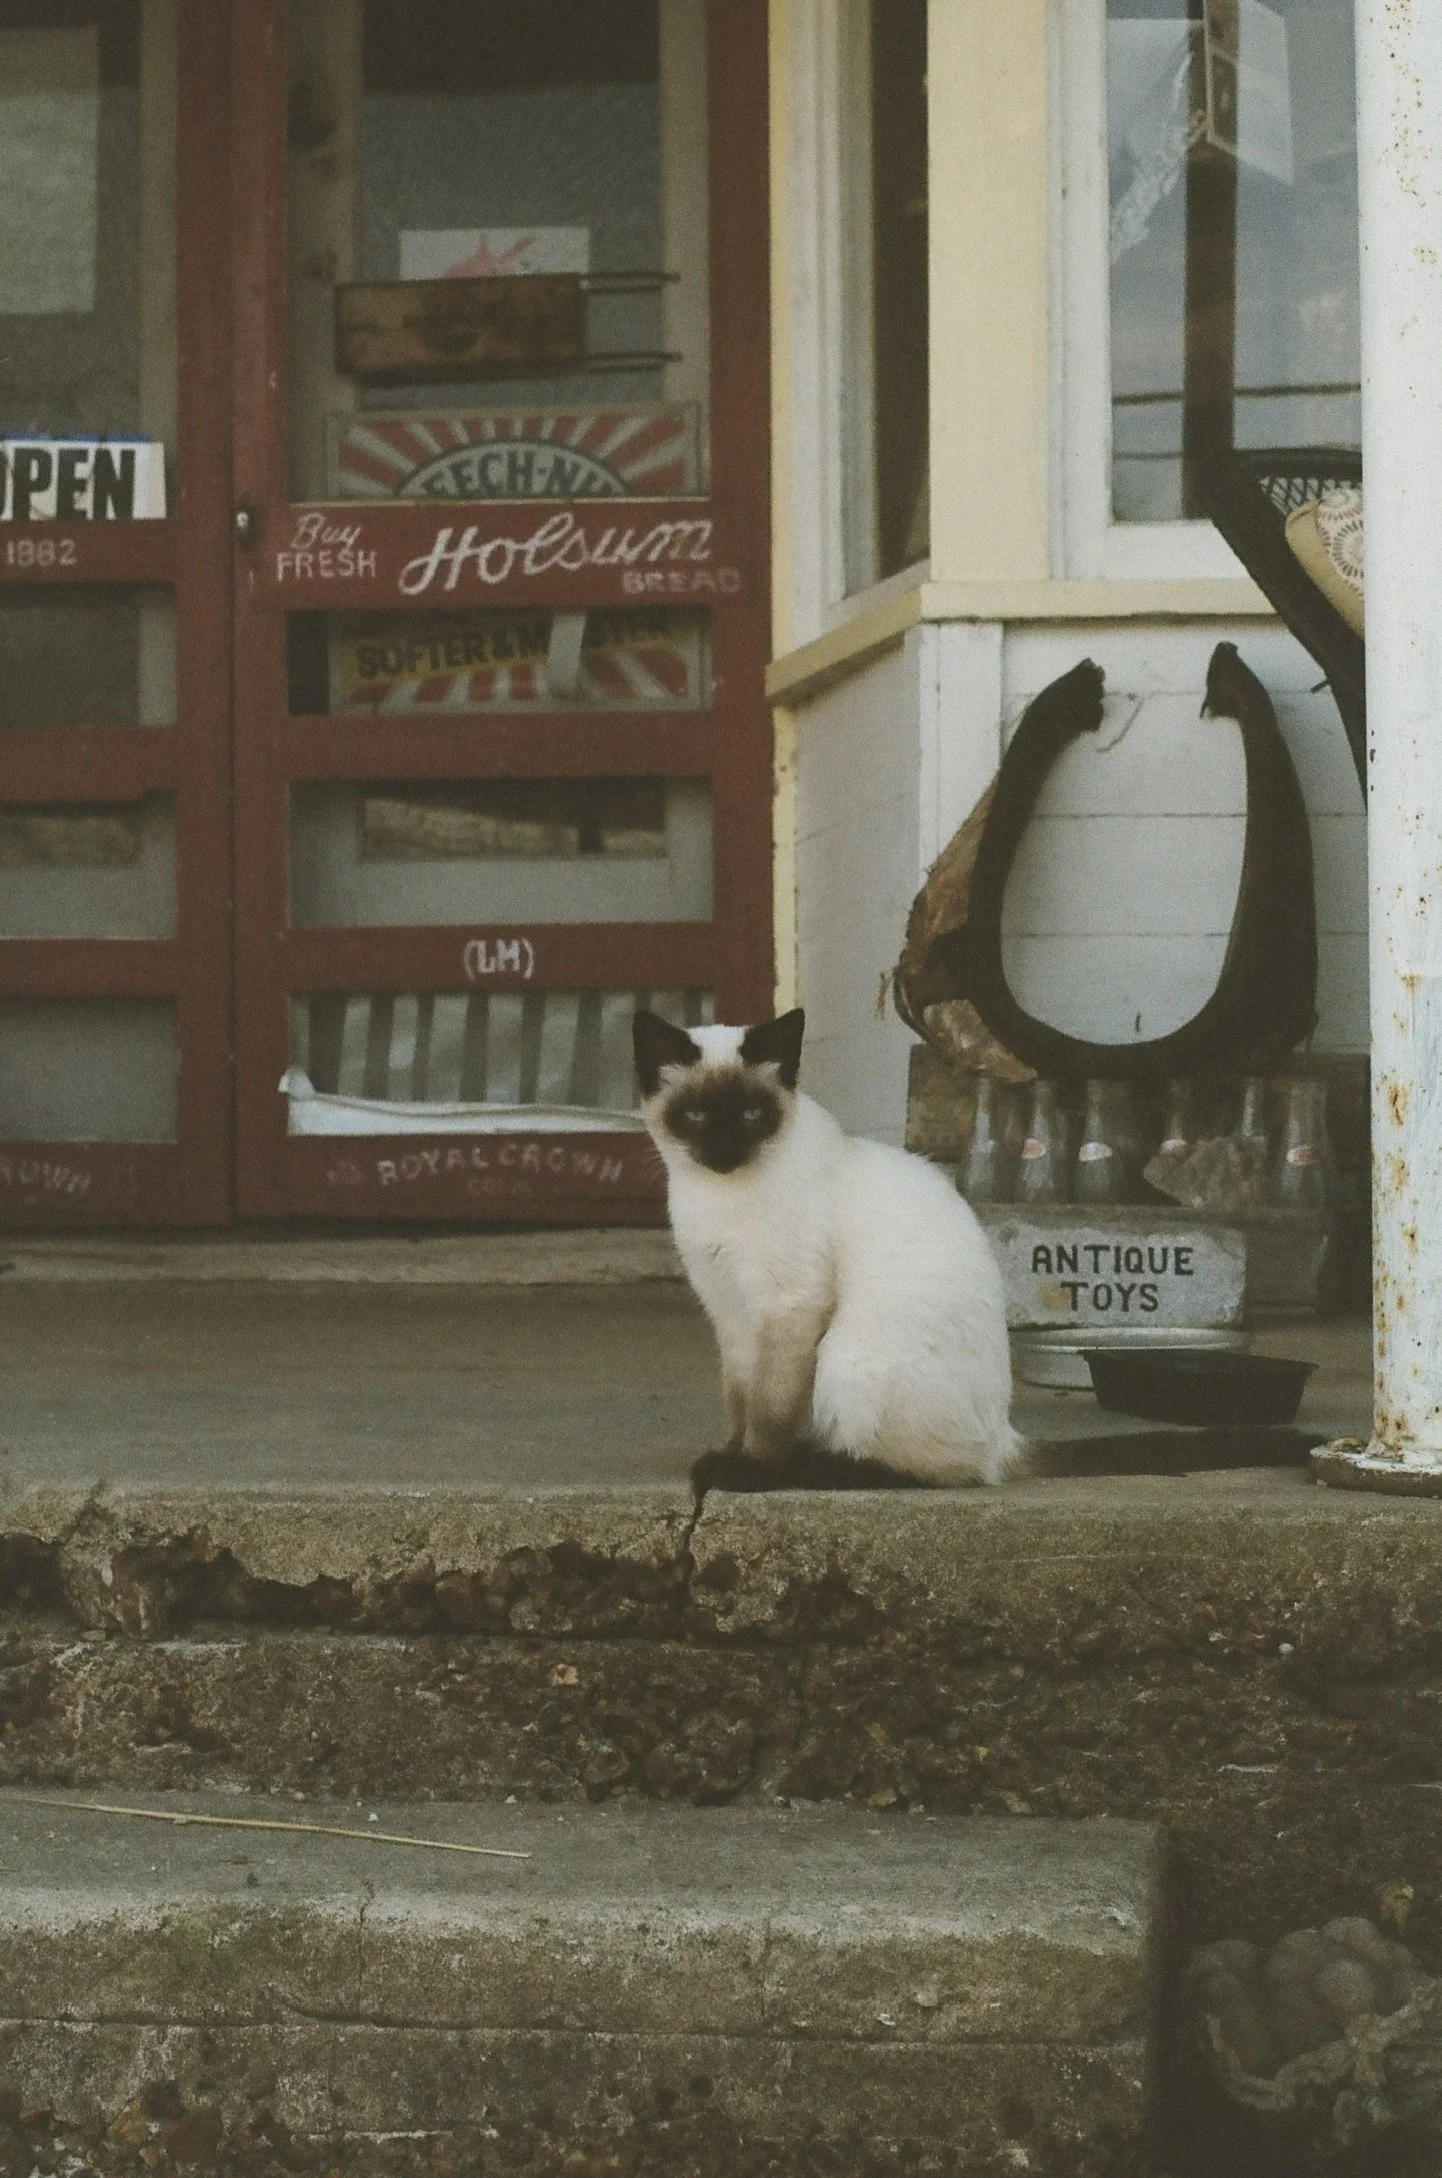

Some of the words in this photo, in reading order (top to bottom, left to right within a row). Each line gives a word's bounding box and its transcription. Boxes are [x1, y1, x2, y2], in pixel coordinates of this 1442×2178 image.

[0, 447, 136, 520] PEN
[290, 512, 361, 550] Buy
[276, 549, 377, 582] FRESH
[398, 511, 713, 595] Holsum
[461, 938, 534, 979] (LM)
[0, 1156, 92, 1195] ROWN
[377, 1147, 489, 1186] ROYAL
[498, 1143, 623, 1183] CROWN
[1031, 1245, 1195, 1277] ANTIQUE
[1060, 1281, 1160, 1313] TOYS
